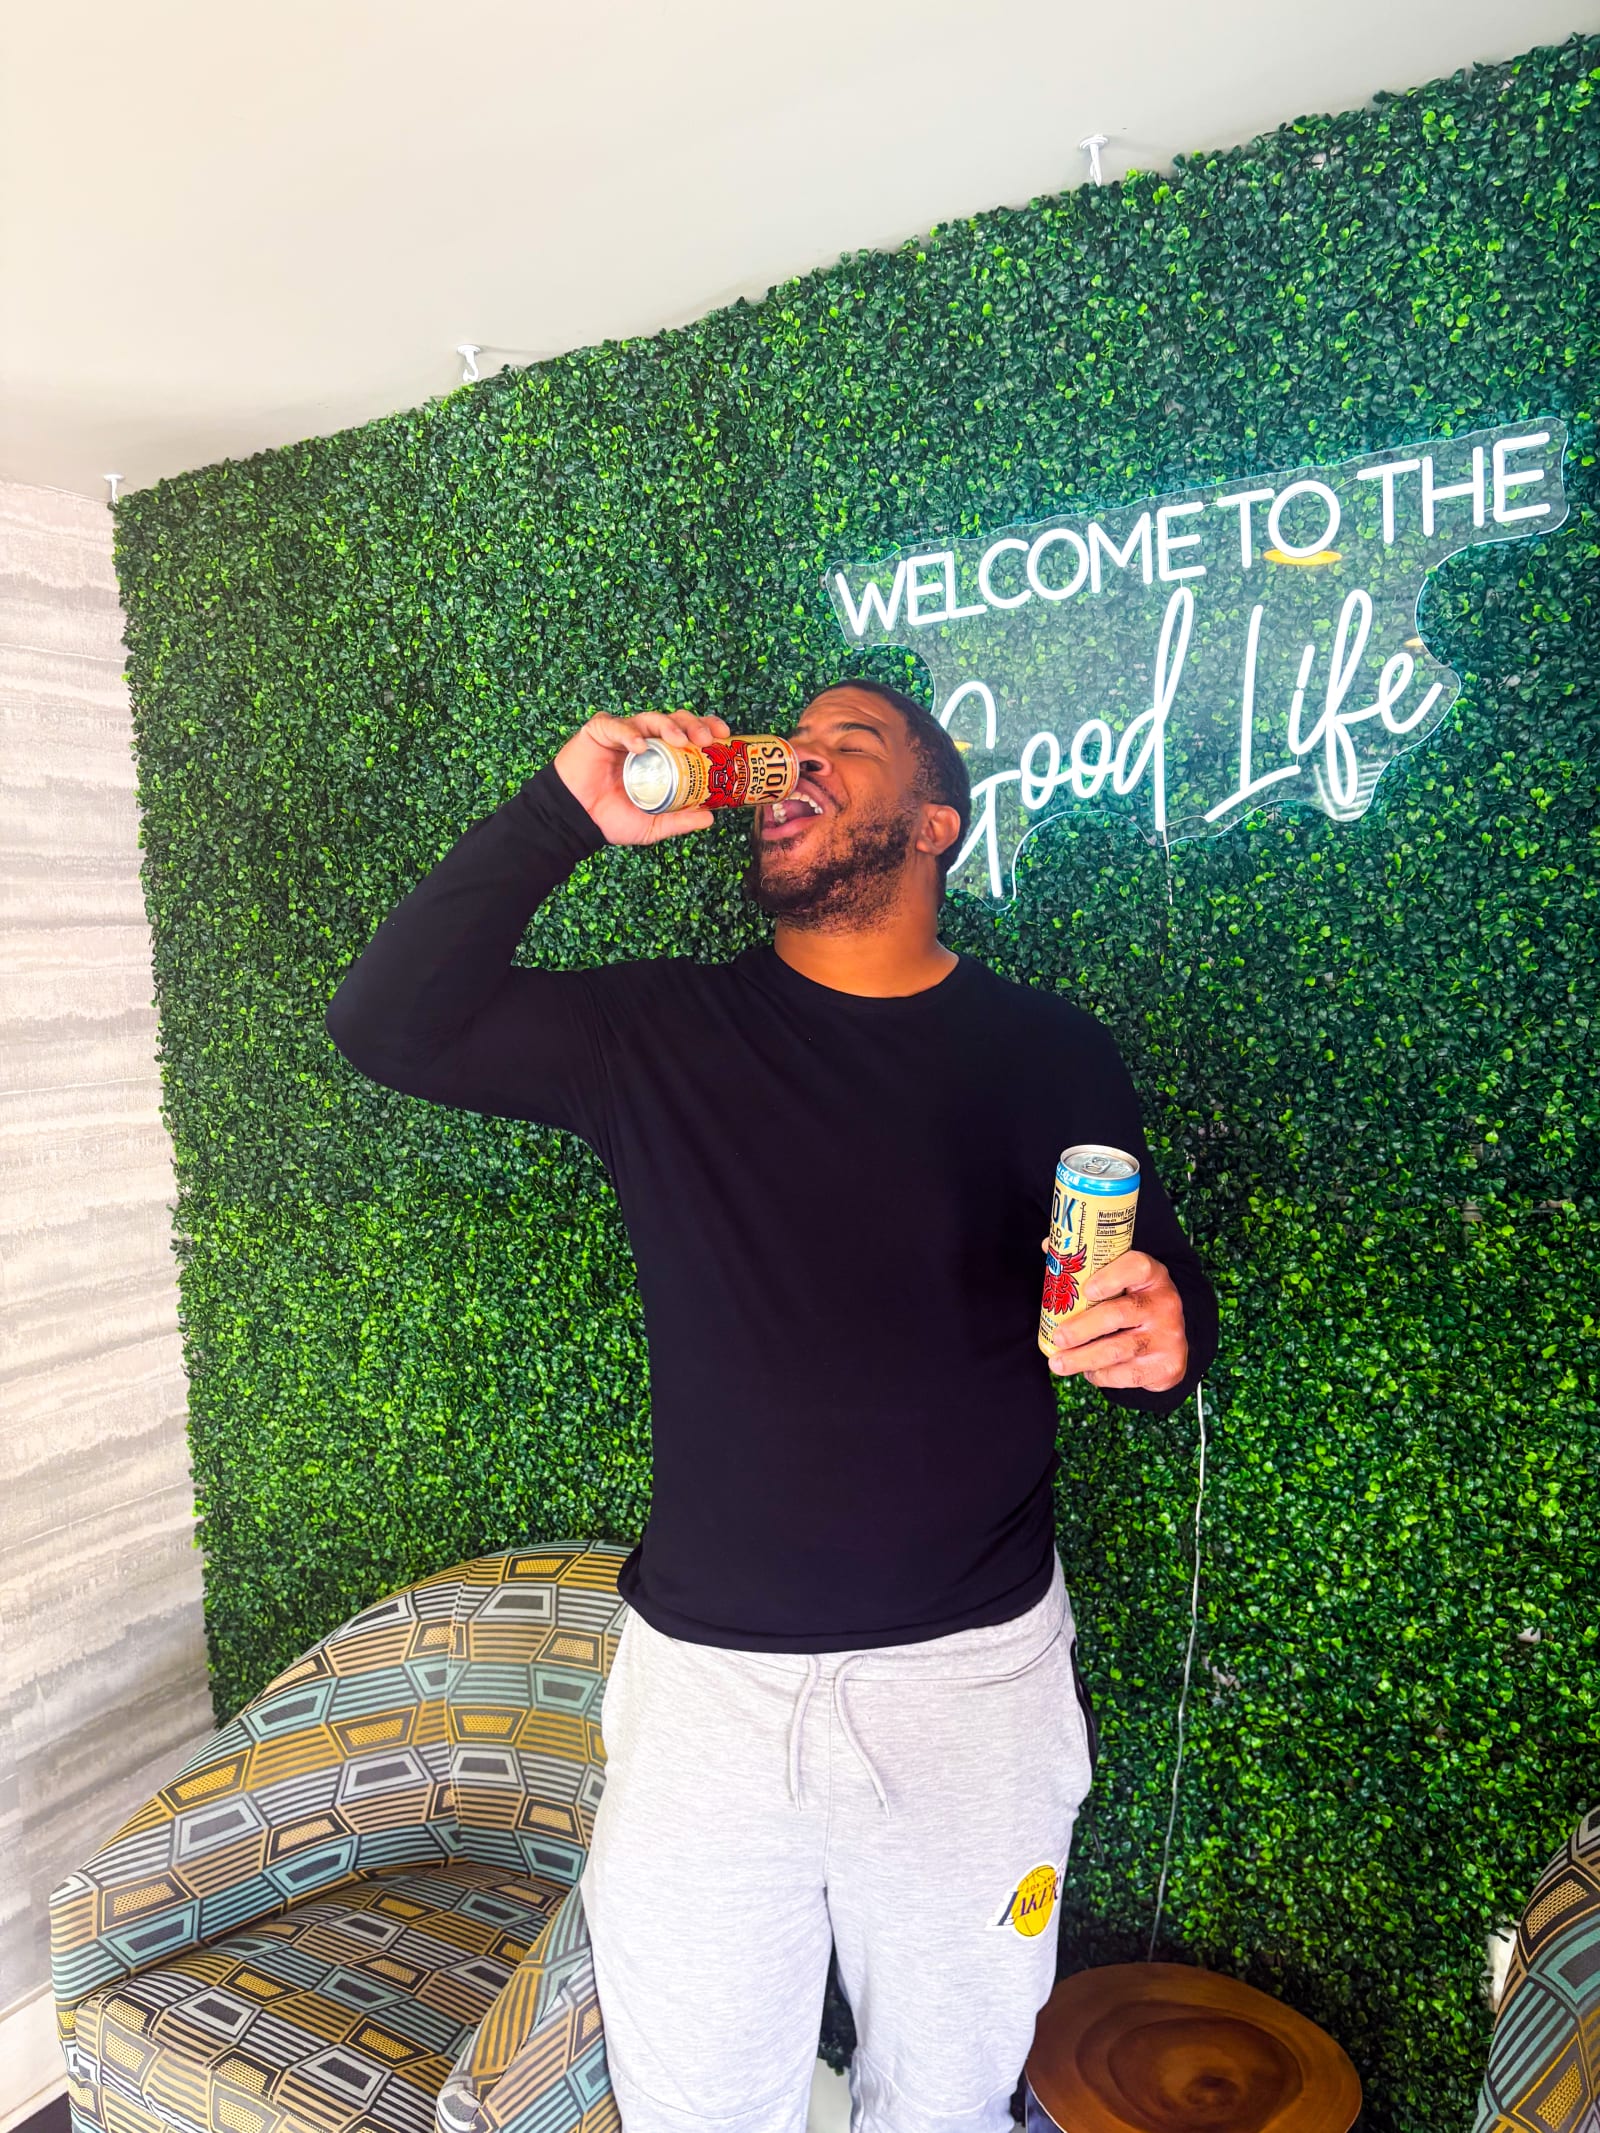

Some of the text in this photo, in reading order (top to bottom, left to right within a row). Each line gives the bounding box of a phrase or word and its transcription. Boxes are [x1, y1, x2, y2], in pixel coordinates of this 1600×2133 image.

[835, 431, 1551, 637] WELCOME TO THE
[947, 587, 1443, 898] Good Life
[734, 759, 747, 796] ENERGY
[749, 757, 759, 795] BREW
[756, 757, 766, 794] COLD
[1098, 1210, 1124, 1219] Nutrition
